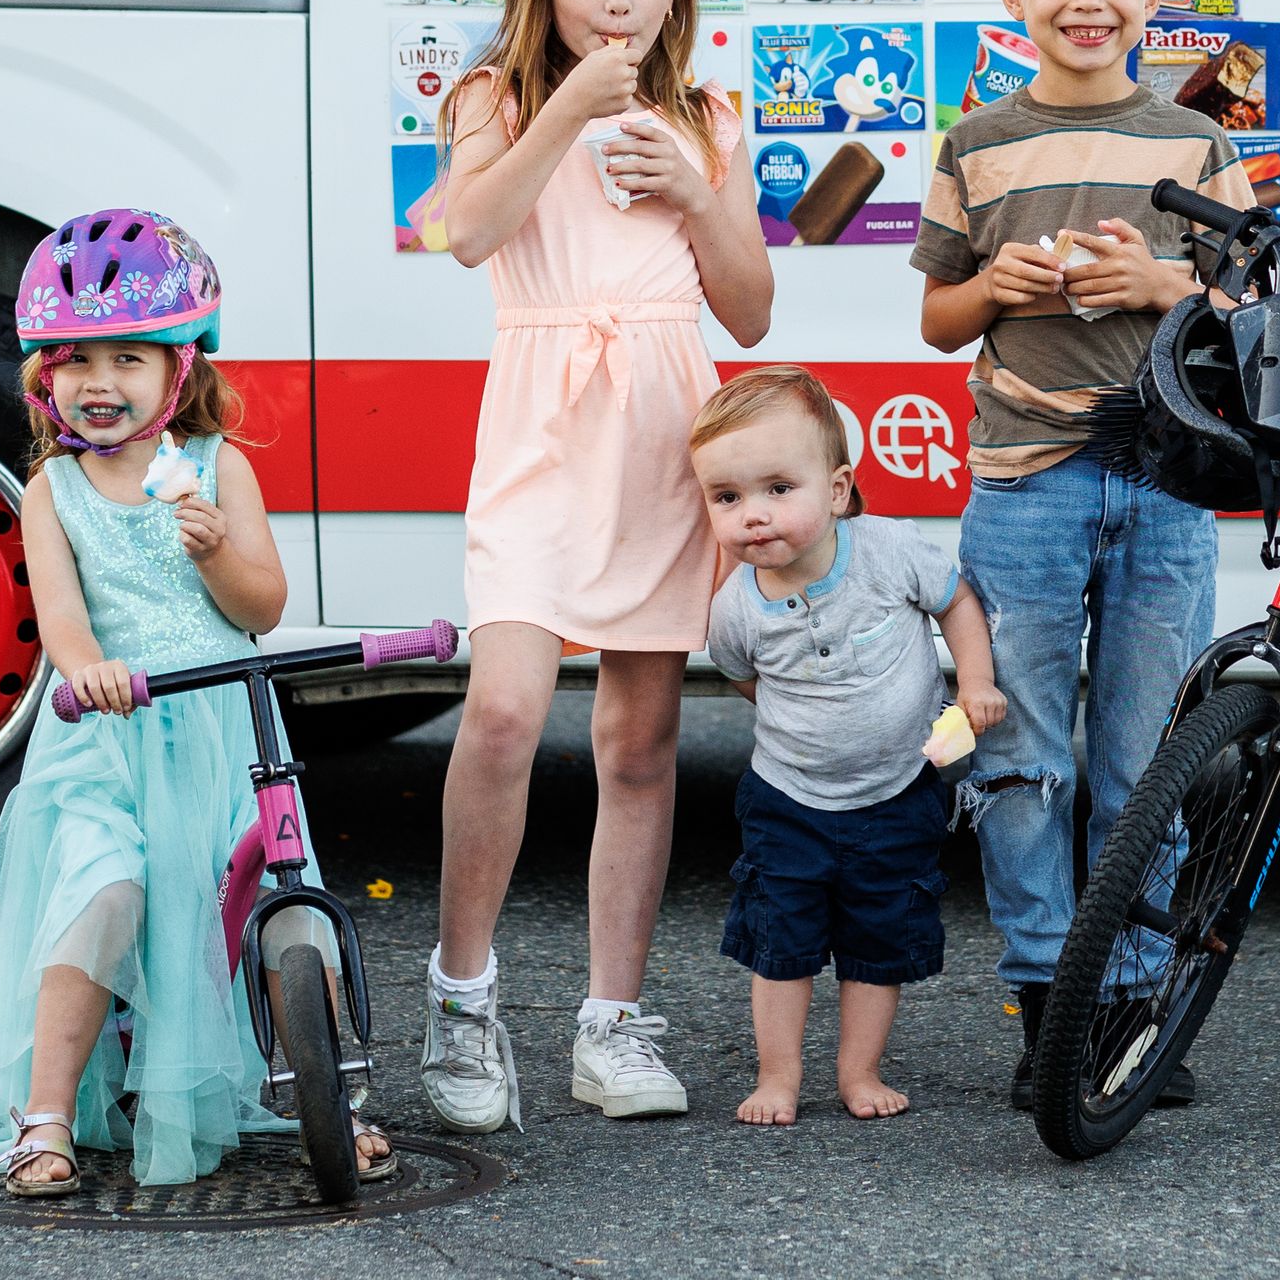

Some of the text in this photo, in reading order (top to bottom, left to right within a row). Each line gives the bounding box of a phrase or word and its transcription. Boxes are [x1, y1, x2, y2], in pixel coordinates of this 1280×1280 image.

[762, 37, 808, 46] BLUE BUNNY
[1144, 30, 1227, 52] FatBoy
[399, 49, 459, 66] LINDY'S
[986, 70, 1023, 88] JOLLY
[763, 100, 822, 117] SONIC
[769, 155, 794, 164] BLUE
[761, 164, 803, 181] RIBBON
[866, 220, 914, 229] FUDGE BAR
